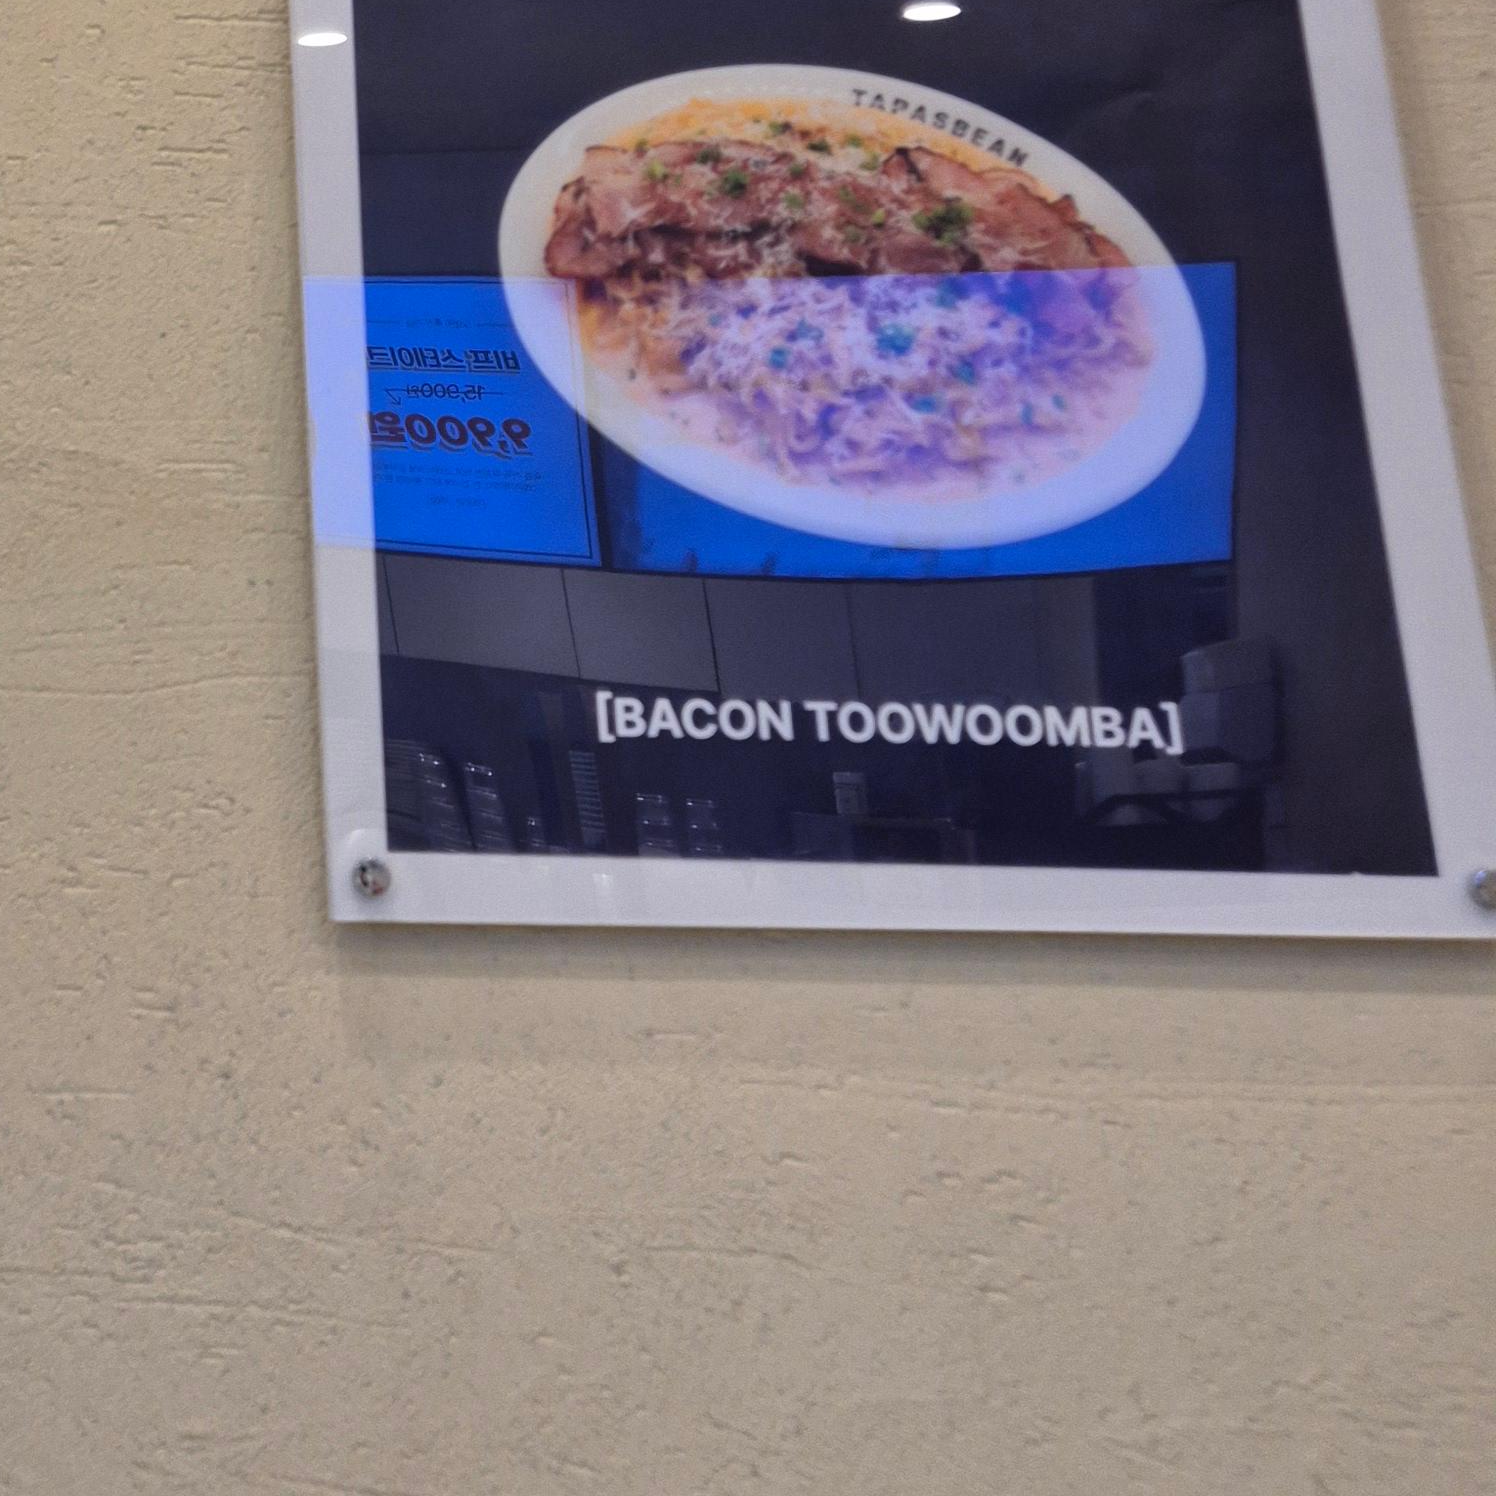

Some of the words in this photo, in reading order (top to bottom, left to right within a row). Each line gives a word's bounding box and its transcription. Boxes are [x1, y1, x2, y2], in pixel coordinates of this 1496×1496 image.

[852, 88, 1029, 167] TAPASBEAN
[595, 690, 794, 743] [BACON
[804, 700, 1185, 756] TOOWOOMBA]
